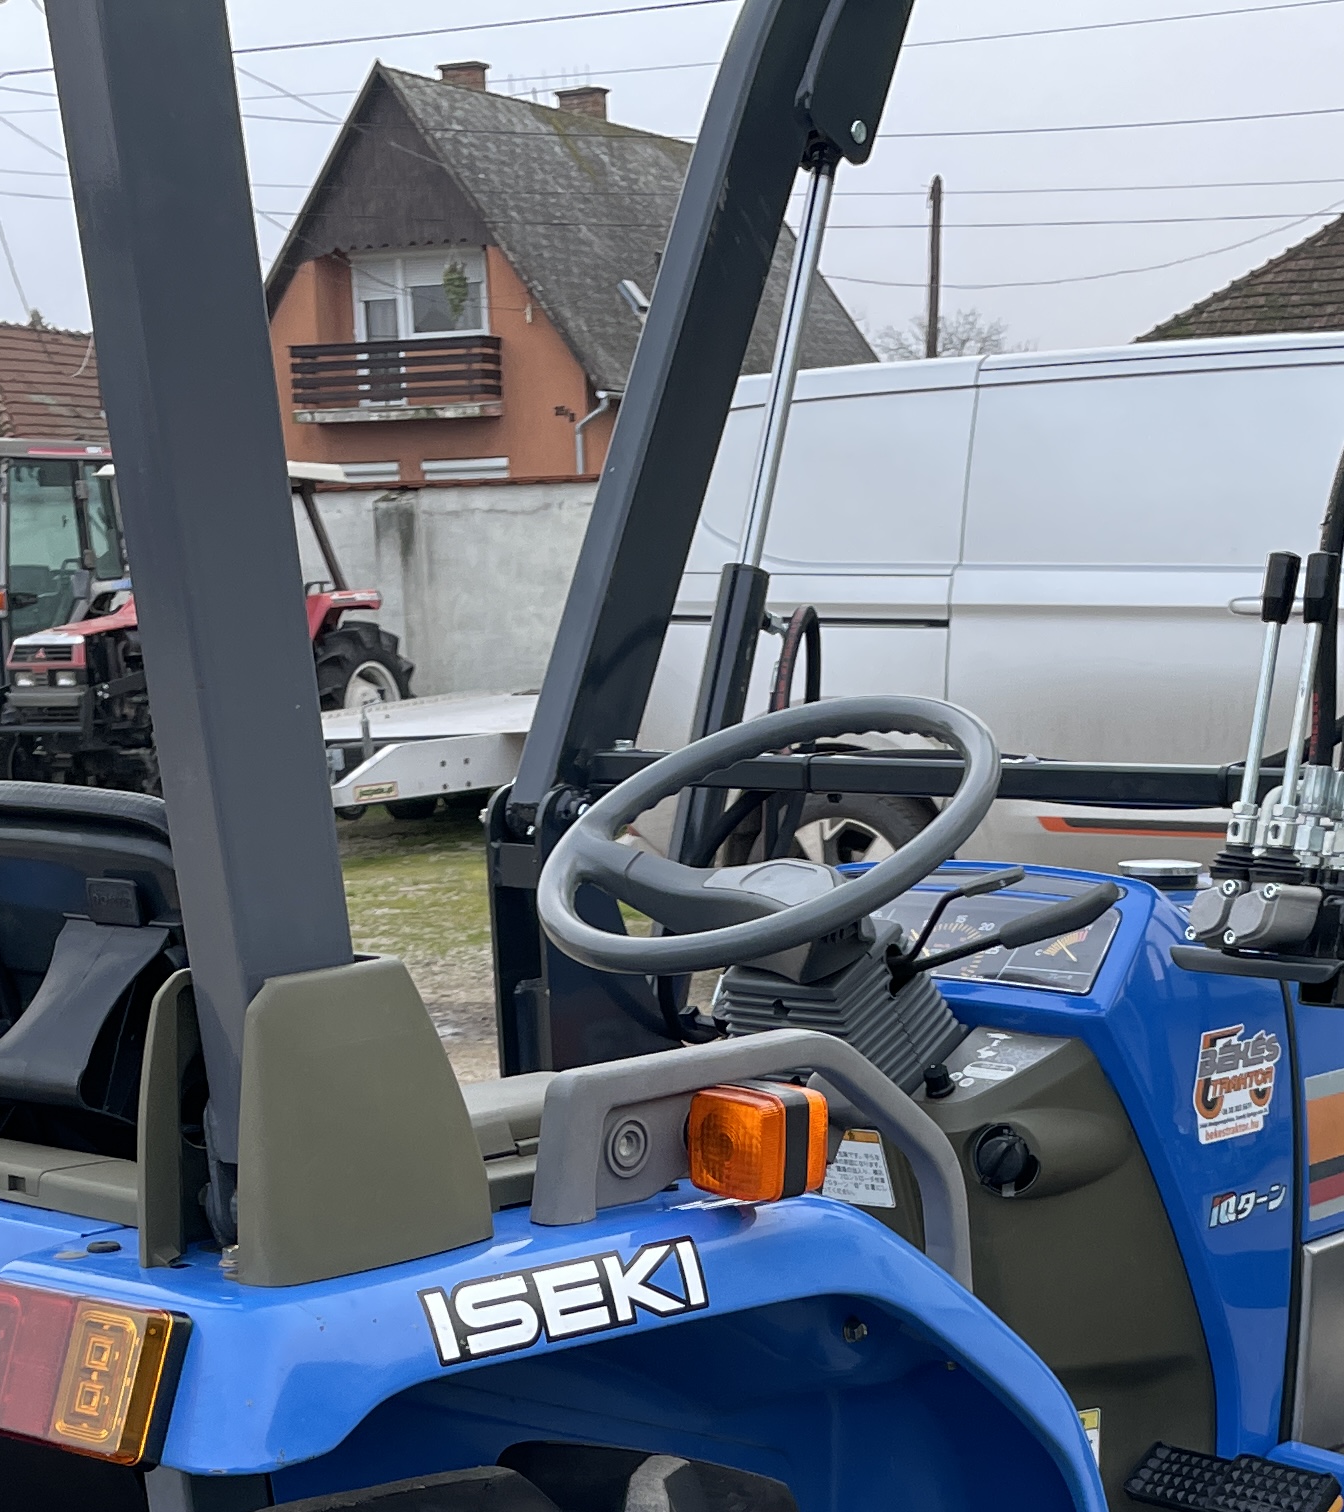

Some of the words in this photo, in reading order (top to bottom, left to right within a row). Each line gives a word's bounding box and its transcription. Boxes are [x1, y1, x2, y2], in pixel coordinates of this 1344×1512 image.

[955, 914, 969, 925] 15
[979, 922, 996, 932] 20
[418, 1237, 708, 1366] ISEKI
